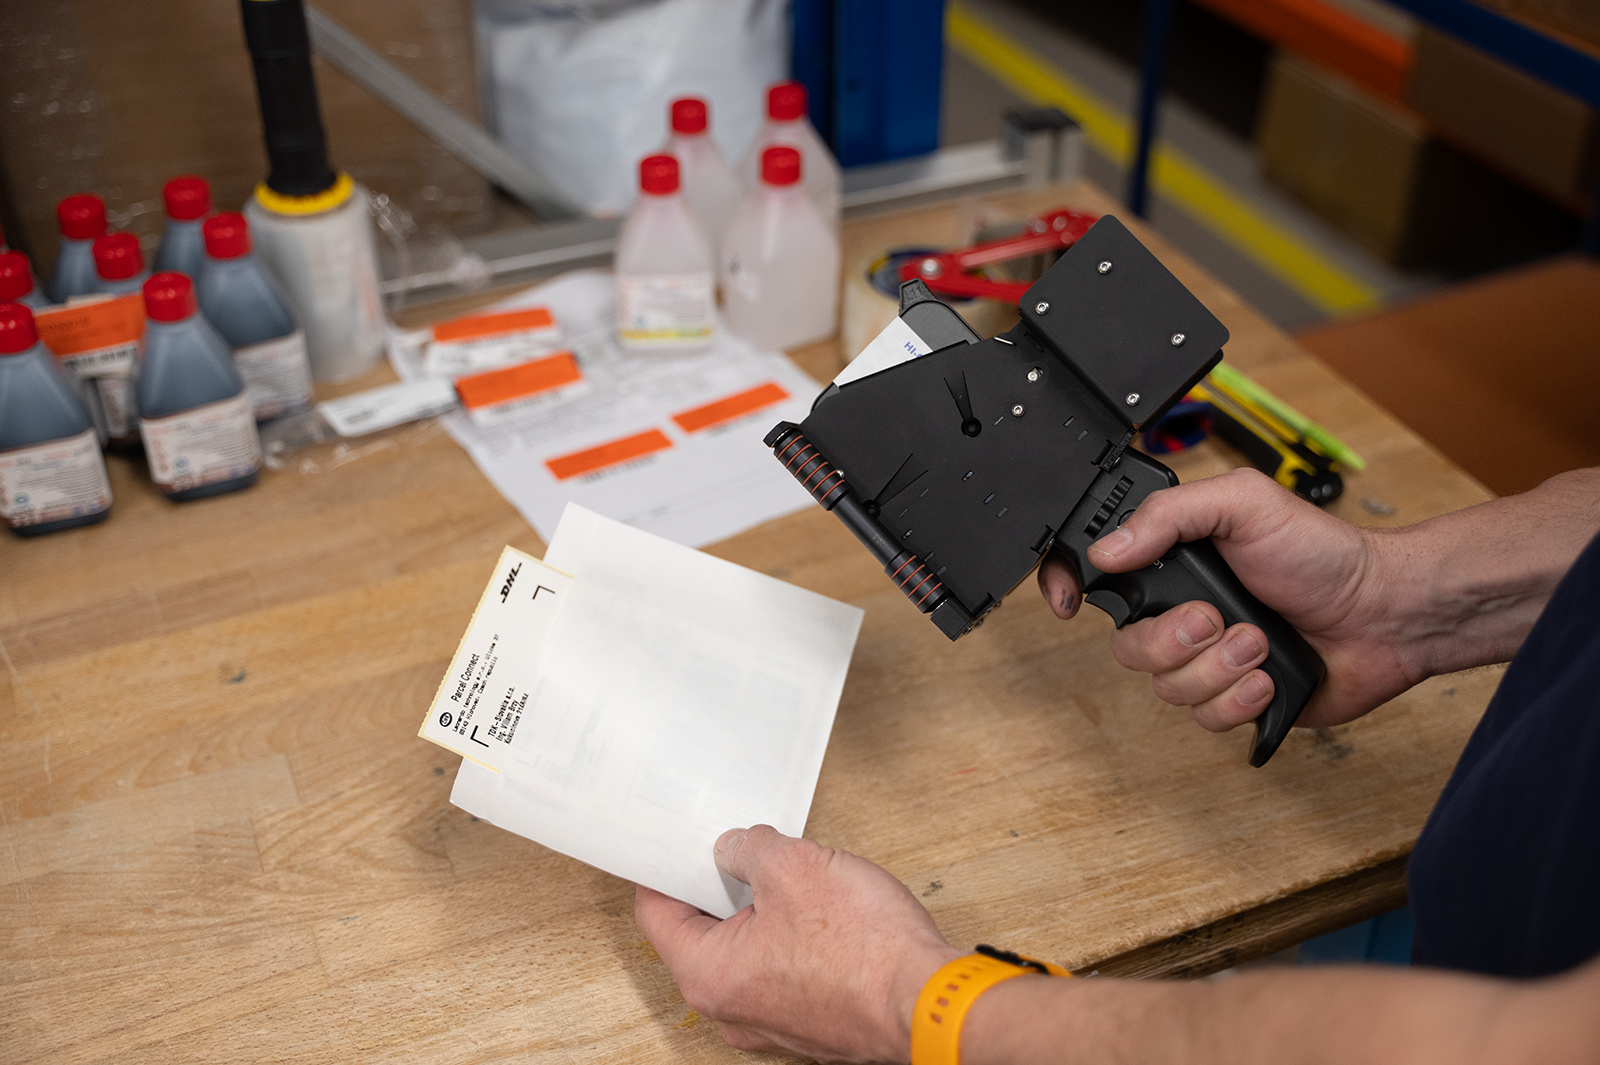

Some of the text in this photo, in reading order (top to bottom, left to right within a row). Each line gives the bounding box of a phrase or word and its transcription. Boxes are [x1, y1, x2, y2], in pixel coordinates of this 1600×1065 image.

[499, 562, 522, 604] DHL
[450, 653, 480, 703] Parcel Connect
[477, 680, 488, 695] Czech
[486, 655, 499, 679] republic
[452, 709, 466, 732] Leonardo
[463, 681, 479, 708] technology
[495, 730, 507, 742] Ing.
